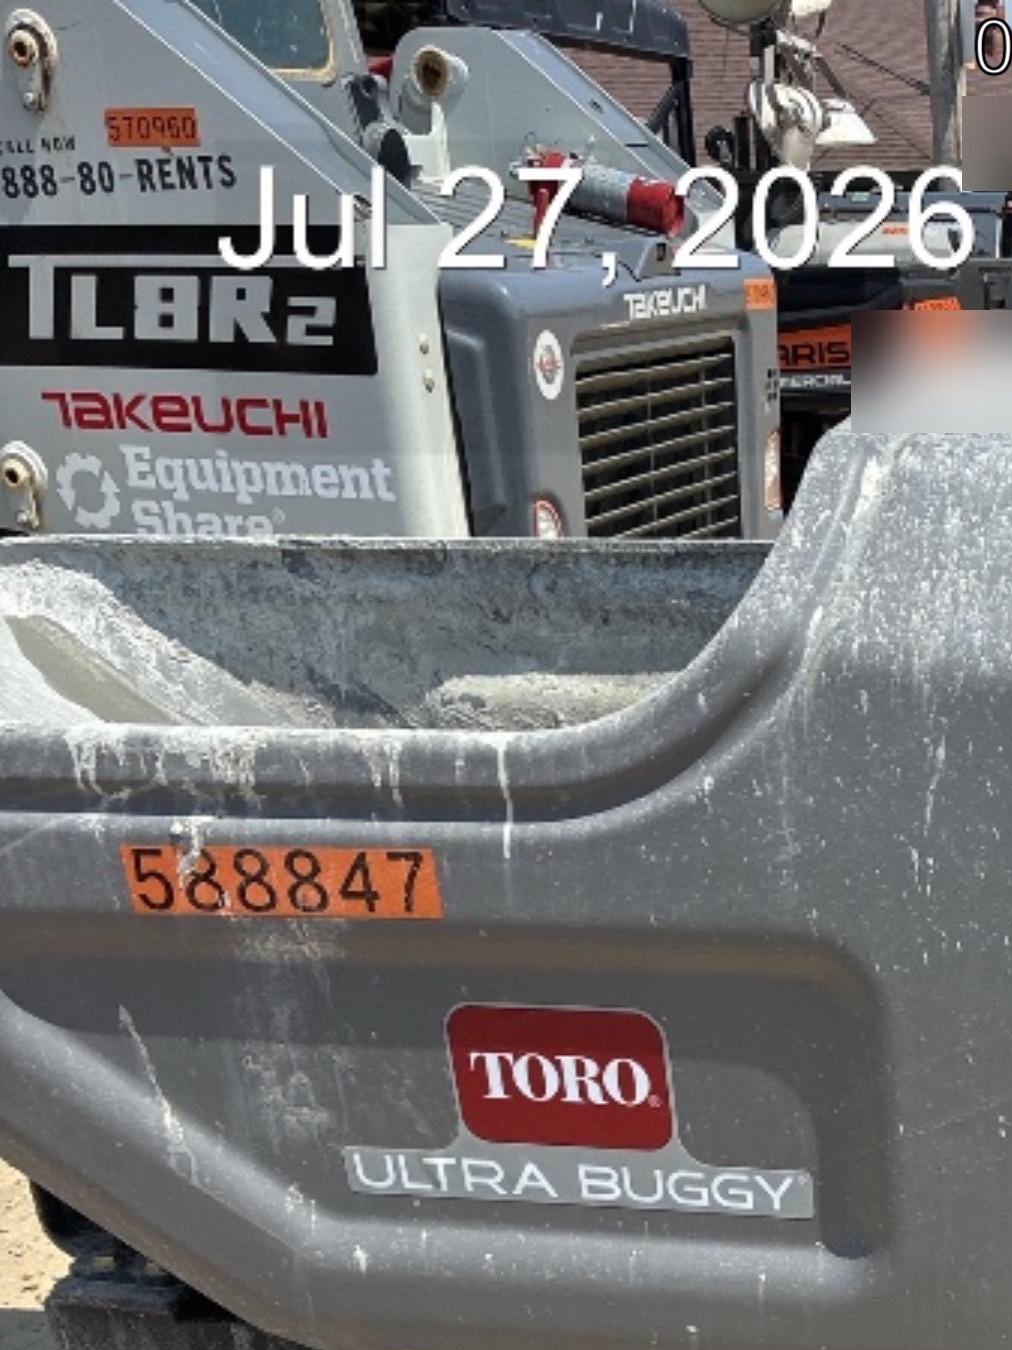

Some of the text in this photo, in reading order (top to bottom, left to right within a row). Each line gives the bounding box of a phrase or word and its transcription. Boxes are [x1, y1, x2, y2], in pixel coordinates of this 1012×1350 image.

[107, 115, 198, 142] 570960
[1, 154, 237, 199] 888-80-RENTS
[8, 254, 337, 347] TL8R2
[41, 391, 328, 439] TAKEUCHI
[119, 443, 397, 505] Equipment
[131, 847, 426, 914] 588847
[469, 1051, 653, 1107] TORO
[353, 1153, 796, 1211] ULTRA BUGGY
